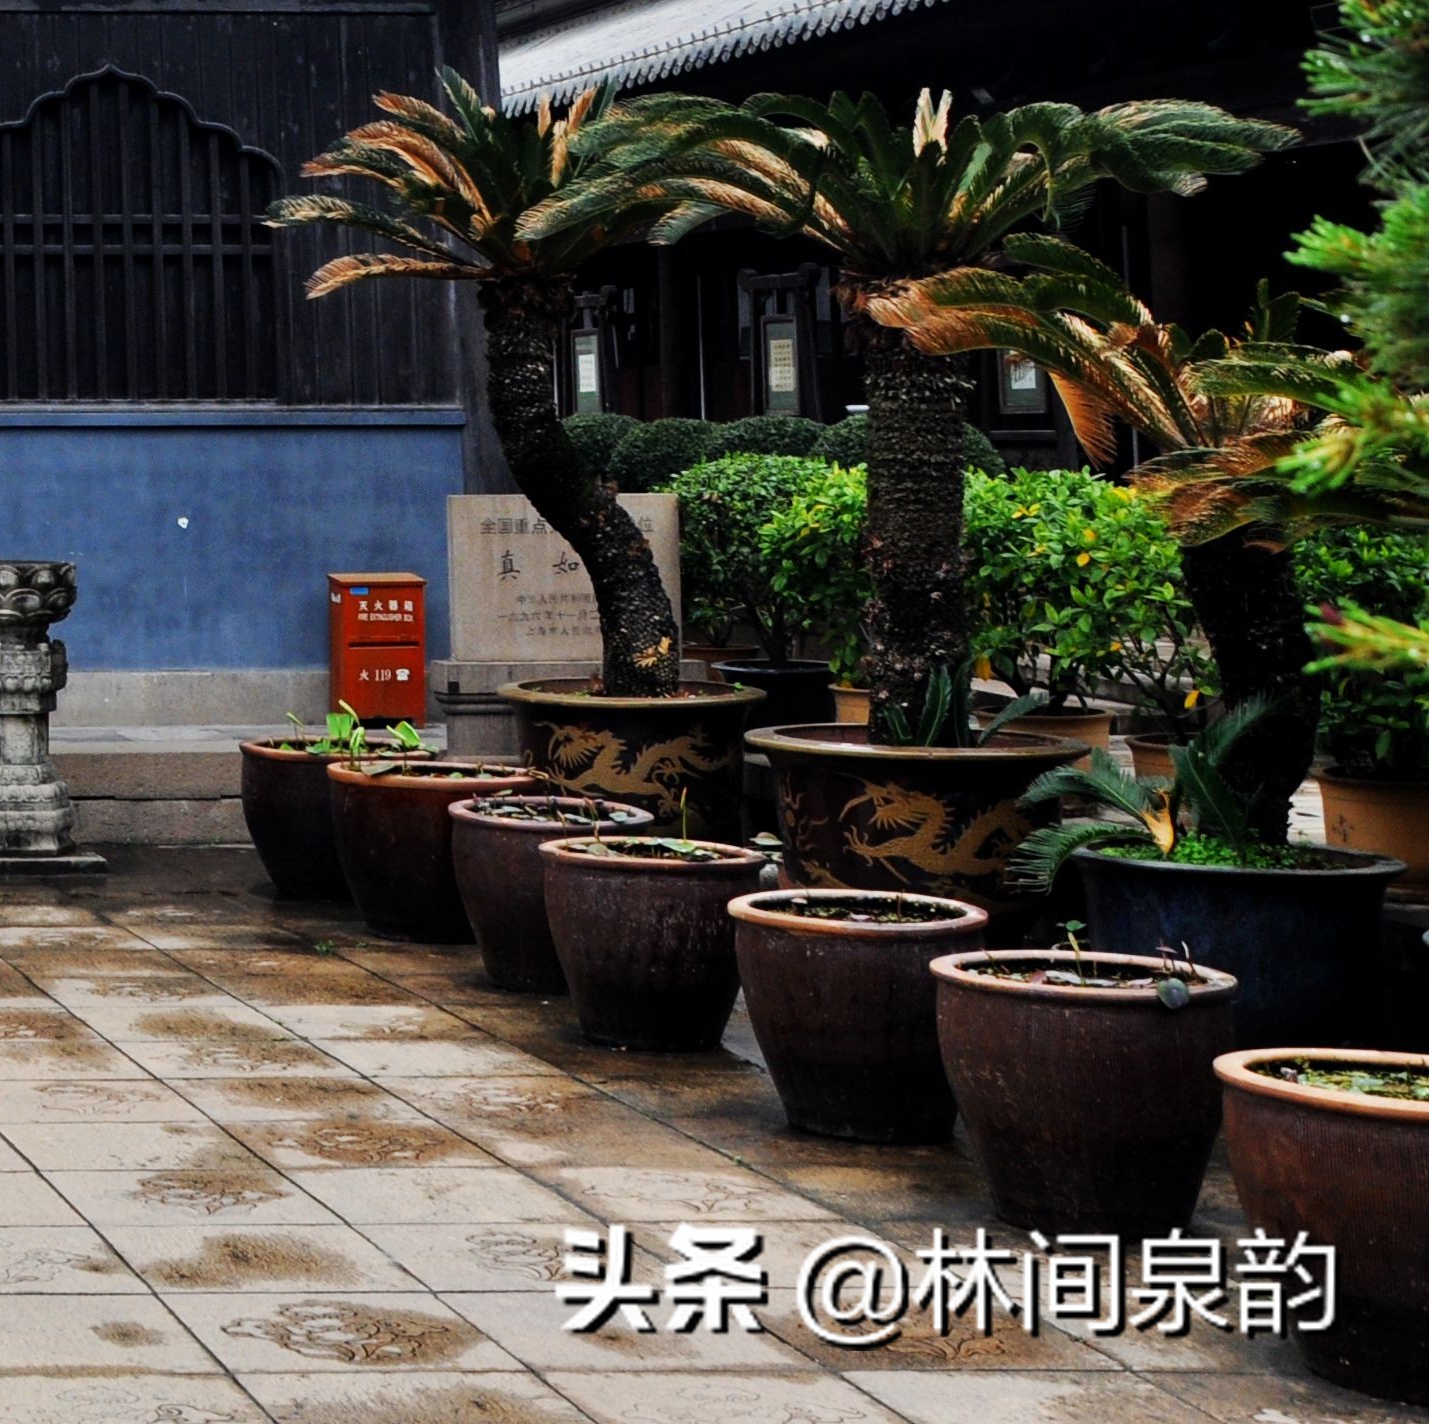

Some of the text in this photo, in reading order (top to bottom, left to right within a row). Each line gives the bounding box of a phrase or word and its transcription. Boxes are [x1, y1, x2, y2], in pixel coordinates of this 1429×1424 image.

[358, 599, 414, 612] 灭火器箱
[374, 668, 392, 681] 119
